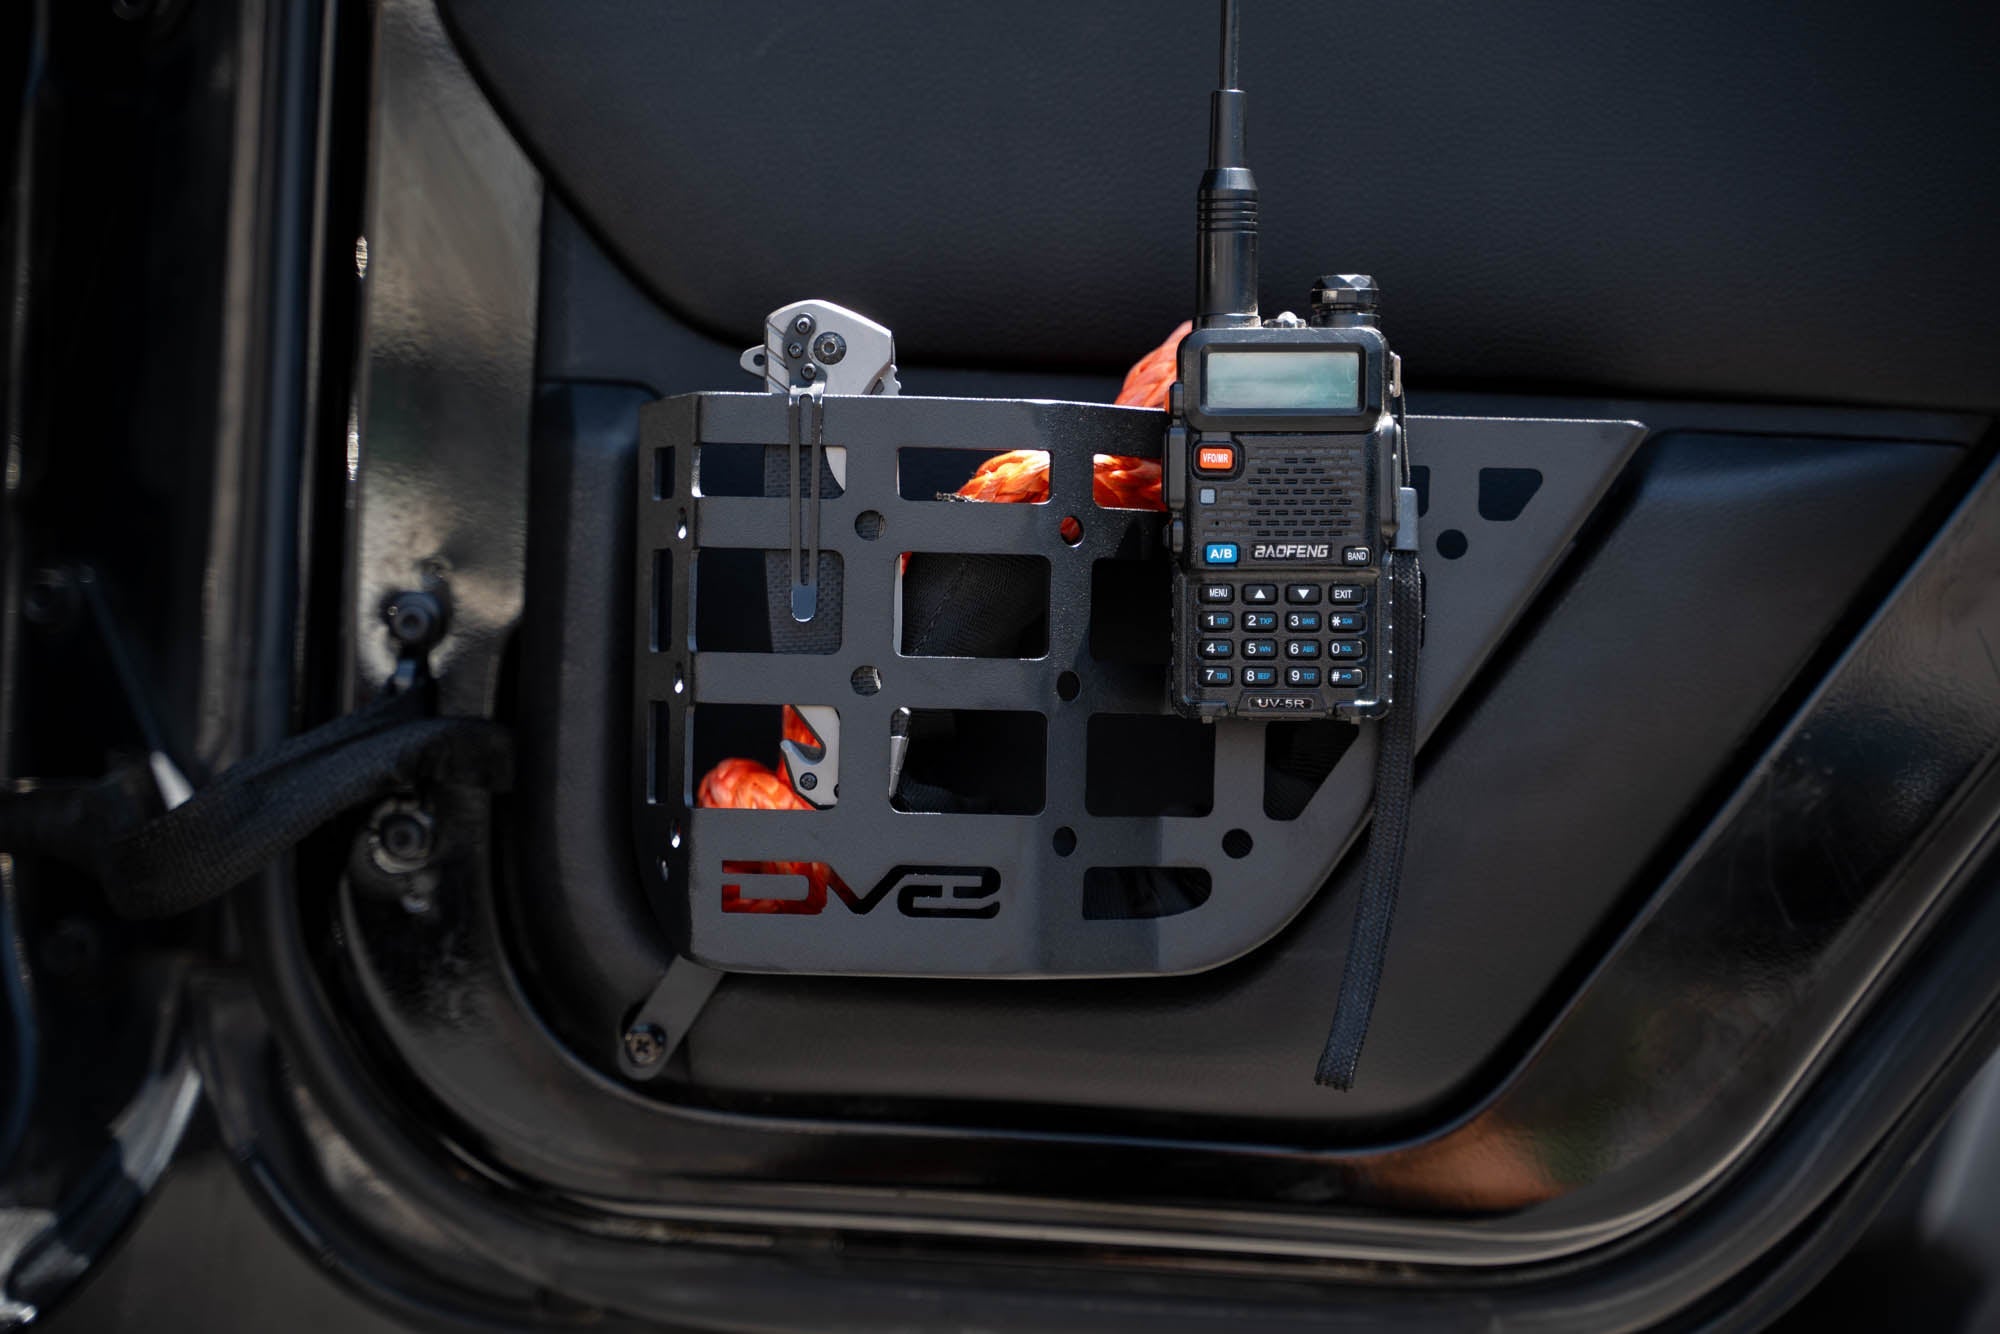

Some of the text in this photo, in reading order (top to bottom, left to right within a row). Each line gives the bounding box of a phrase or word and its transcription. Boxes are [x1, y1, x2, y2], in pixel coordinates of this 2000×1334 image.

[1203, 454, 1228, 463] VFO/MR
[1210, 549, 1233, 559] A/B
[1255, 545, 1328, 557] BAOFENG
[1348, 552, 1366, 560] BAND
[1210, 589, 1228, 597] MENU
[1335, 590, 1352, 598] EXIT
[1208, 616, 1214, 625] 1
[1248, 616, 1256, 625] 2
[1291, 616, 1298, 625] 3
[1206, 644, 1215, 653] 4
[1248, 644, 1256, 653] 5
[1291, 644, 1298, 653] 6
[1332, 644, 1340, 653] 0
[1207, 670, 1214, 680] 7
[1247, 671, 1255, 680] 8
[1292, 671, 1299, 680] 9
[1331, 671, 1340, 681] #
[1257, 698, 1305, 707] UV-5R
